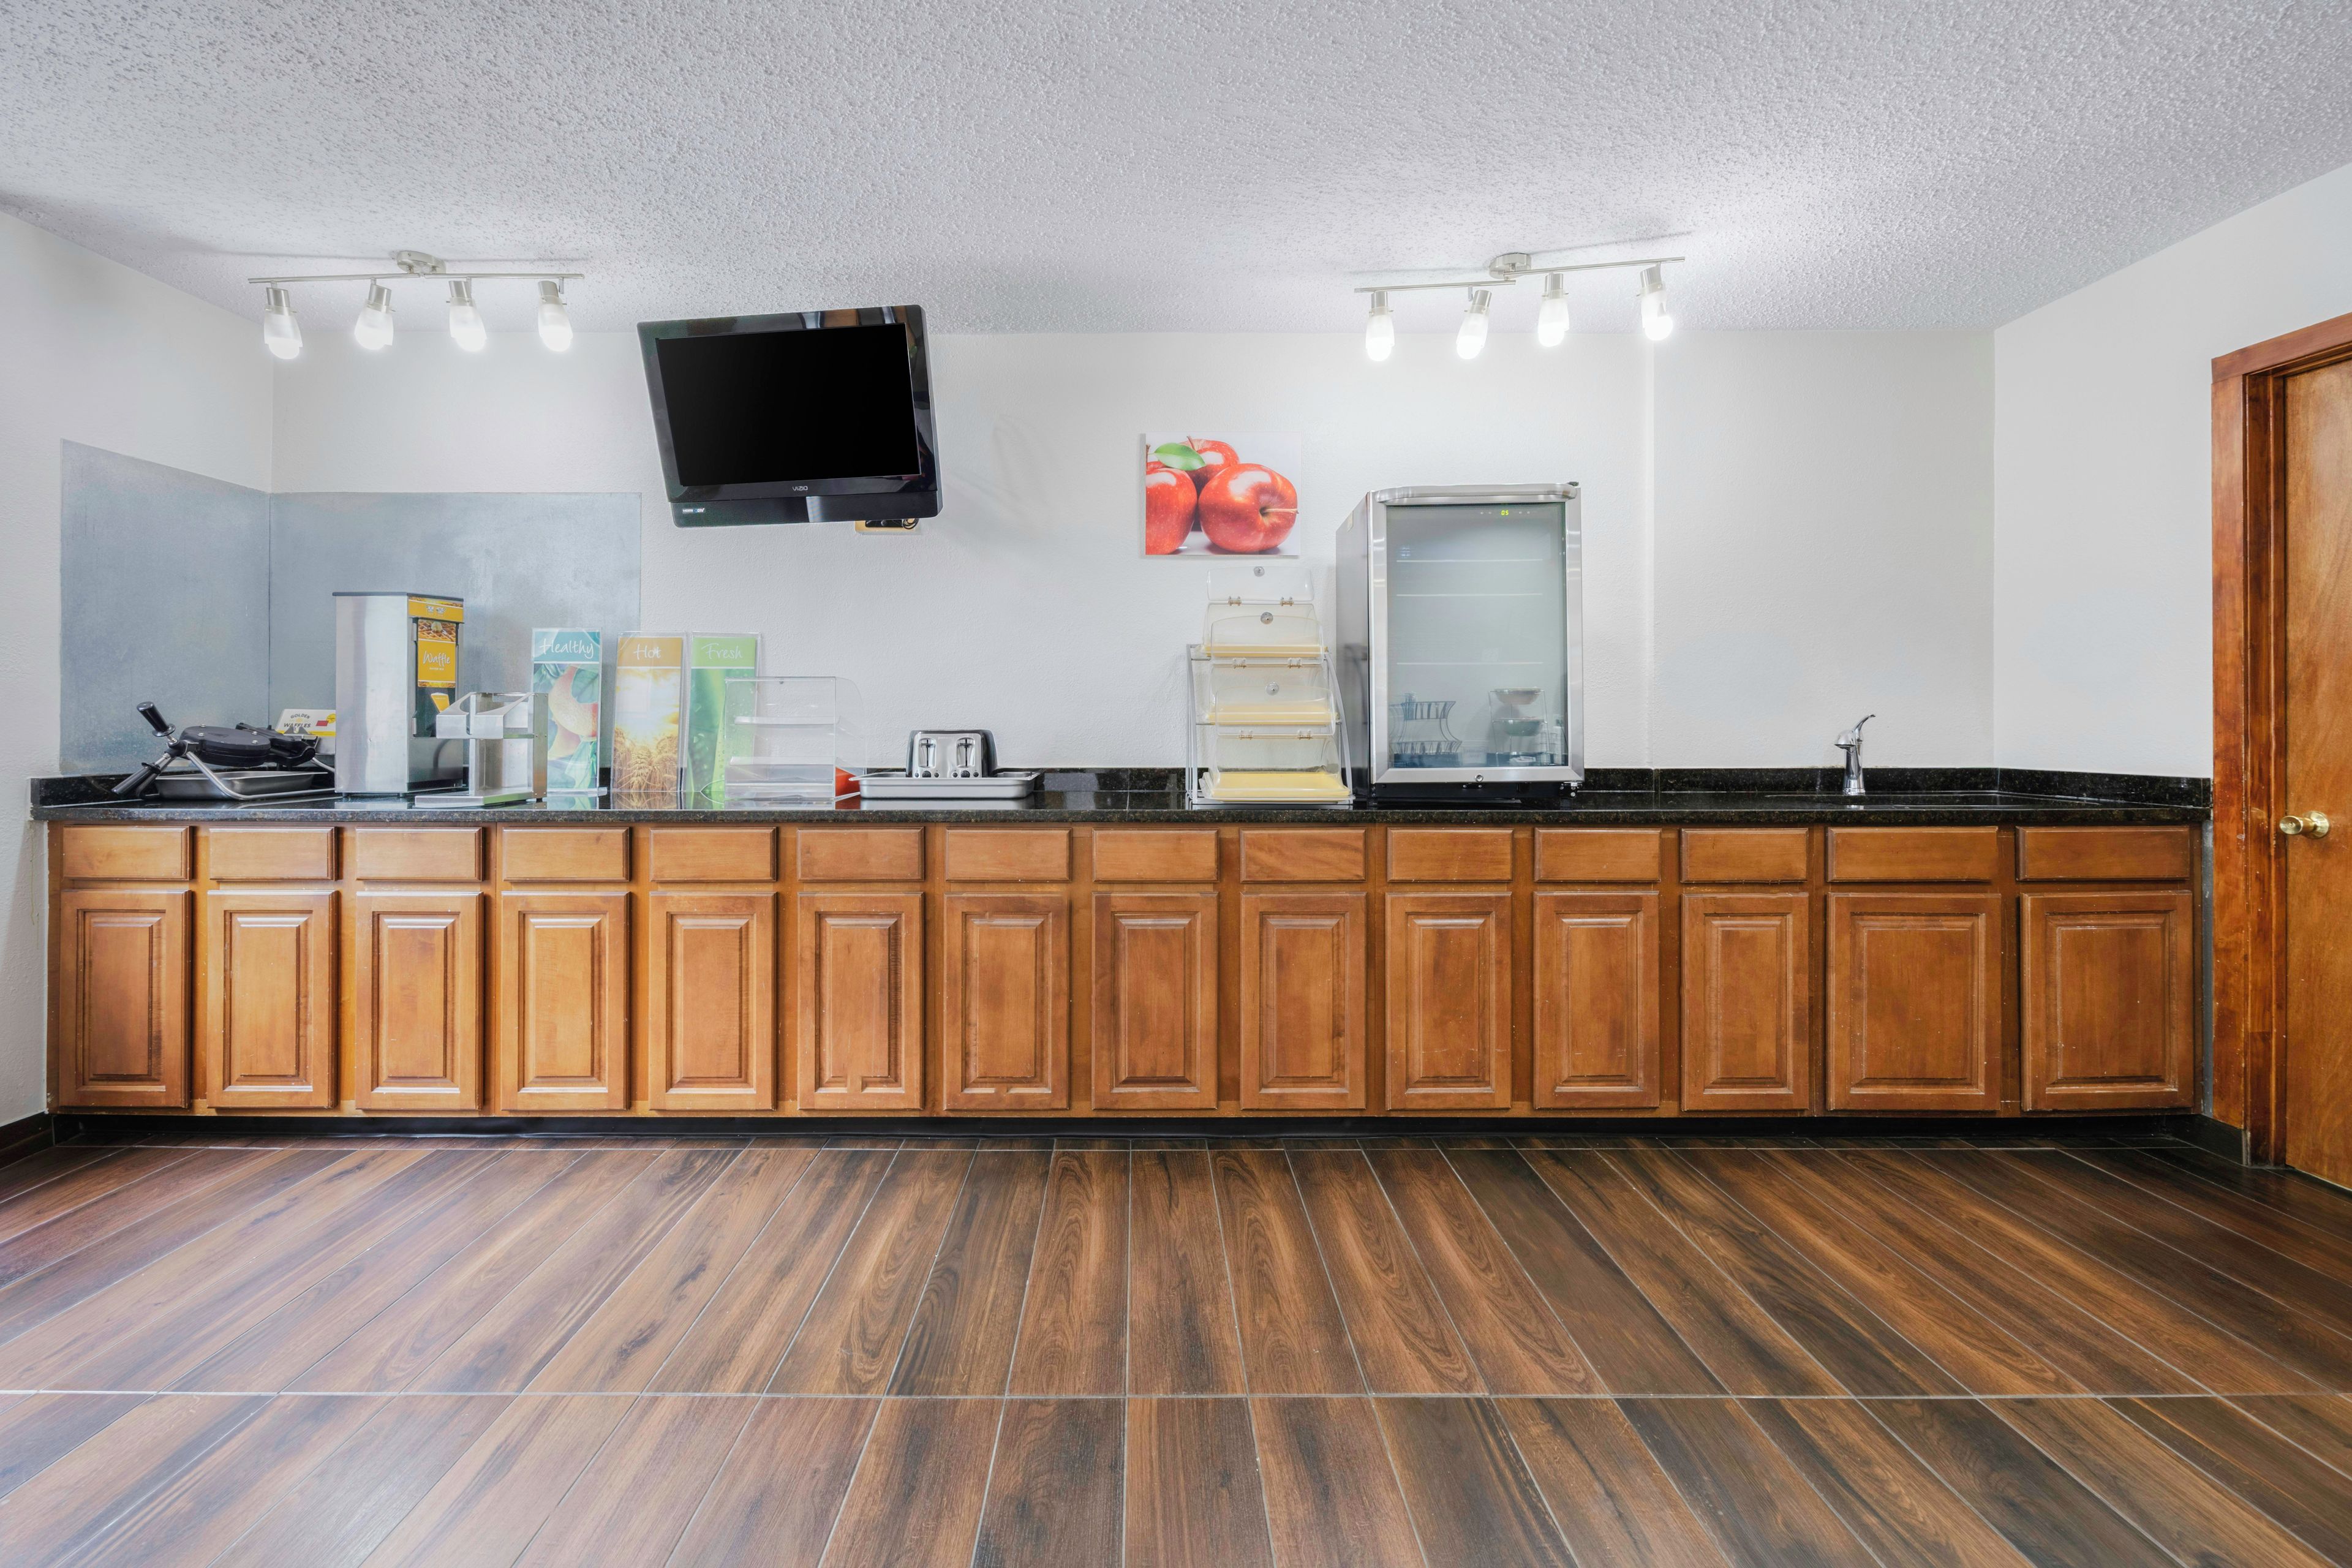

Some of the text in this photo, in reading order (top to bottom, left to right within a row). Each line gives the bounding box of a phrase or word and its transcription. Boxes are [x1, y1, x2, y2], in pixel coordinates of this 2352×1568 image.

[539, 638, 594, 659] Healthy
[633, 643, 662, 660] Hot
[701, 643, 743, 660] Fresh
[423, 650, 450, 667] Waffle
